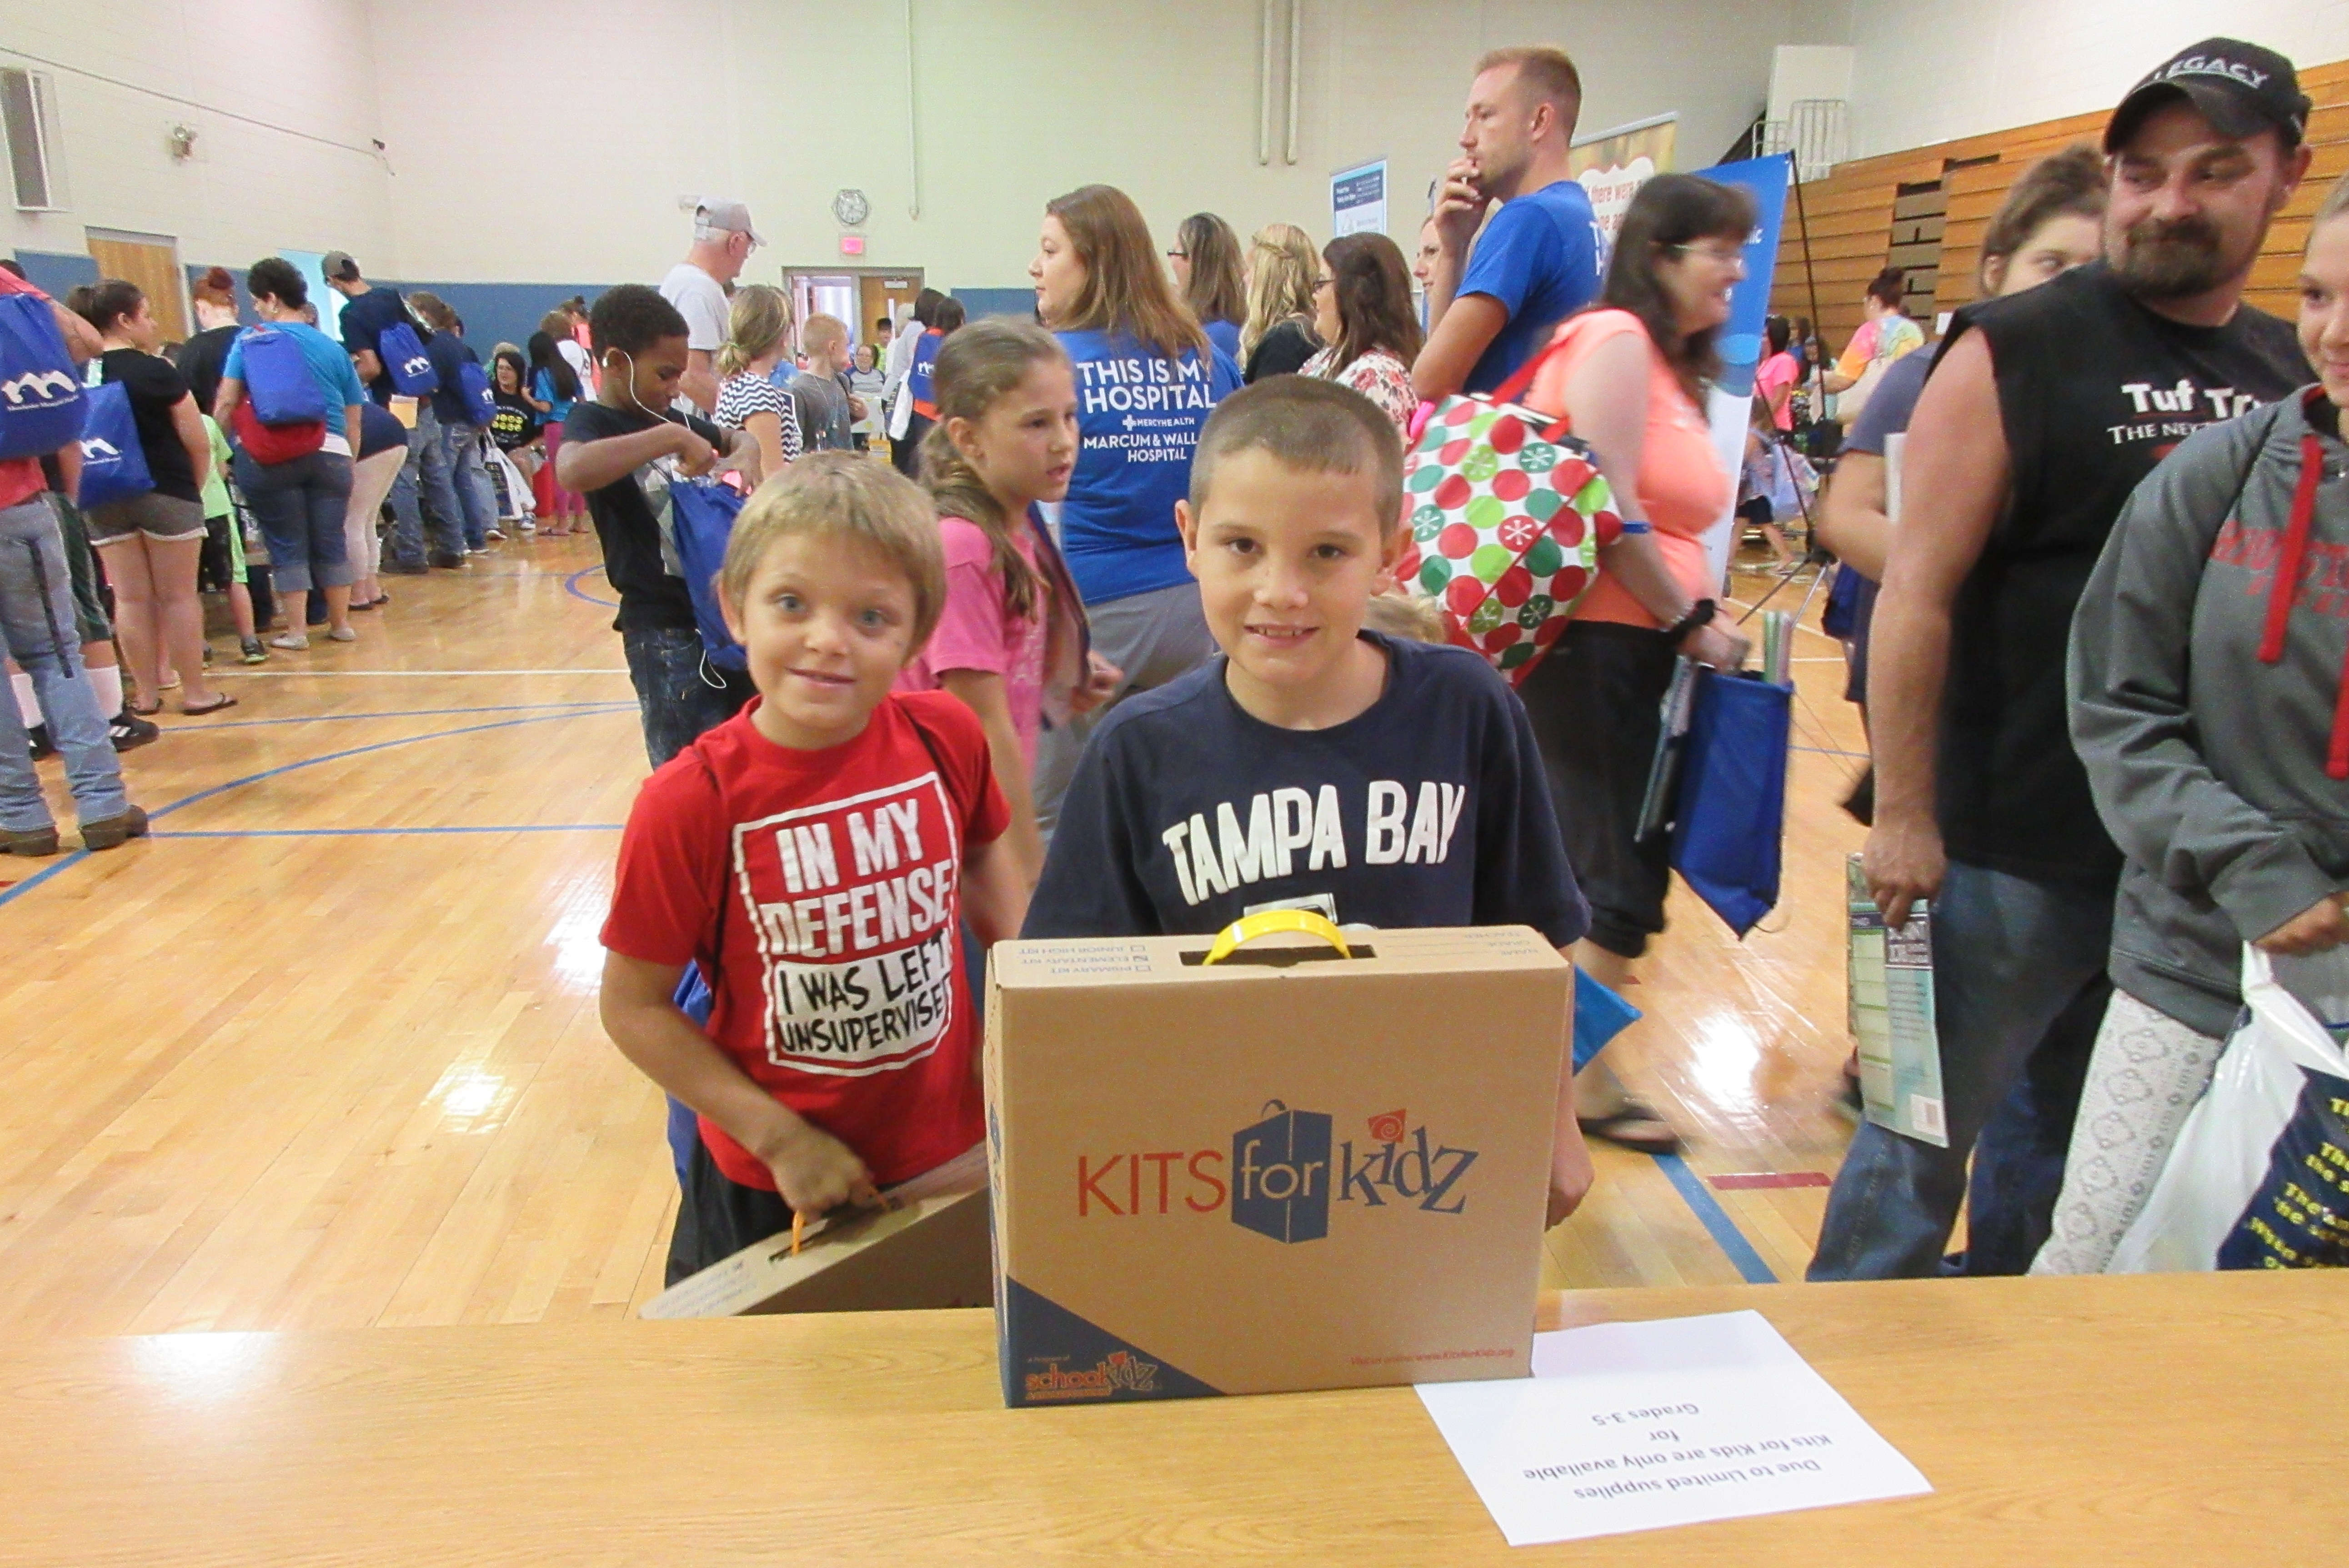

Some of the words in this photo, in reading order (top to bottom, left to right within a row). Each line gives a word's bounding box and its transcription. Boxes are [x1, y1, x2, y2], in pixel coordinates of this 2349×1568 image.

[1077, 359, 1144, 386] THIS
[1148, 359, 1170, 383] IS
[1084, 384, 1217, 413] HOSPITAL
[2121, 378, 2195, 413] Tuf
[2204, 387, 2262, 418] Tr
[1137, 417, 1195, 427] MERCYHEALTH
[1084, 435, 1151, 449] MARCUM
[1153, 434, 1161, 446] &
[1163, 432, 1198, 445] WALL
[2107, 424, 2158, 445] THE
[2162, 422, 2199, 437] NE
[1128, 449, 1187, 462] HOSPITAL
[776, 822, 839, 893] IN
[846, 799, 923, 876] MY
[1162, 784, 1347, 906] TAMPA
[1365, 780, 1465, 864] BAY
[759, 859, 952, 957] DEFENSE
[779, 970, 795, 1016] I
[800, 967, 869, 1013] WAS
[877, 927, 946, 1000] LEFT
[1078, 1150, 1227, 1216] KITS
[1241, 1138, 1322, 1201] for
[1336, 1109, 1480, 1214] kidz
[1592, 1412, 1626, 1426] 3-5
[1628, 1403, 1698, 1419] Grades
[1649, 1429, 1679, 1442] for
[1790, 1434, 1833, 1447] Kits
[1709, 1443, 1756, 1458] Kids
[1758, 1439, 1791, 1451] for
[1623, 1453, 1667, 1469] only
[1672, 1449, 1705, 1461] are
[1523, 1458, 1617, 1481] available
[1749, 1466, 1774, 1476] to
[1776, 1459, 1821, 1472] Due
[1666, 1470, 1748, 1491] Limited
[1574, 1480, 1663, 1499] supplies
